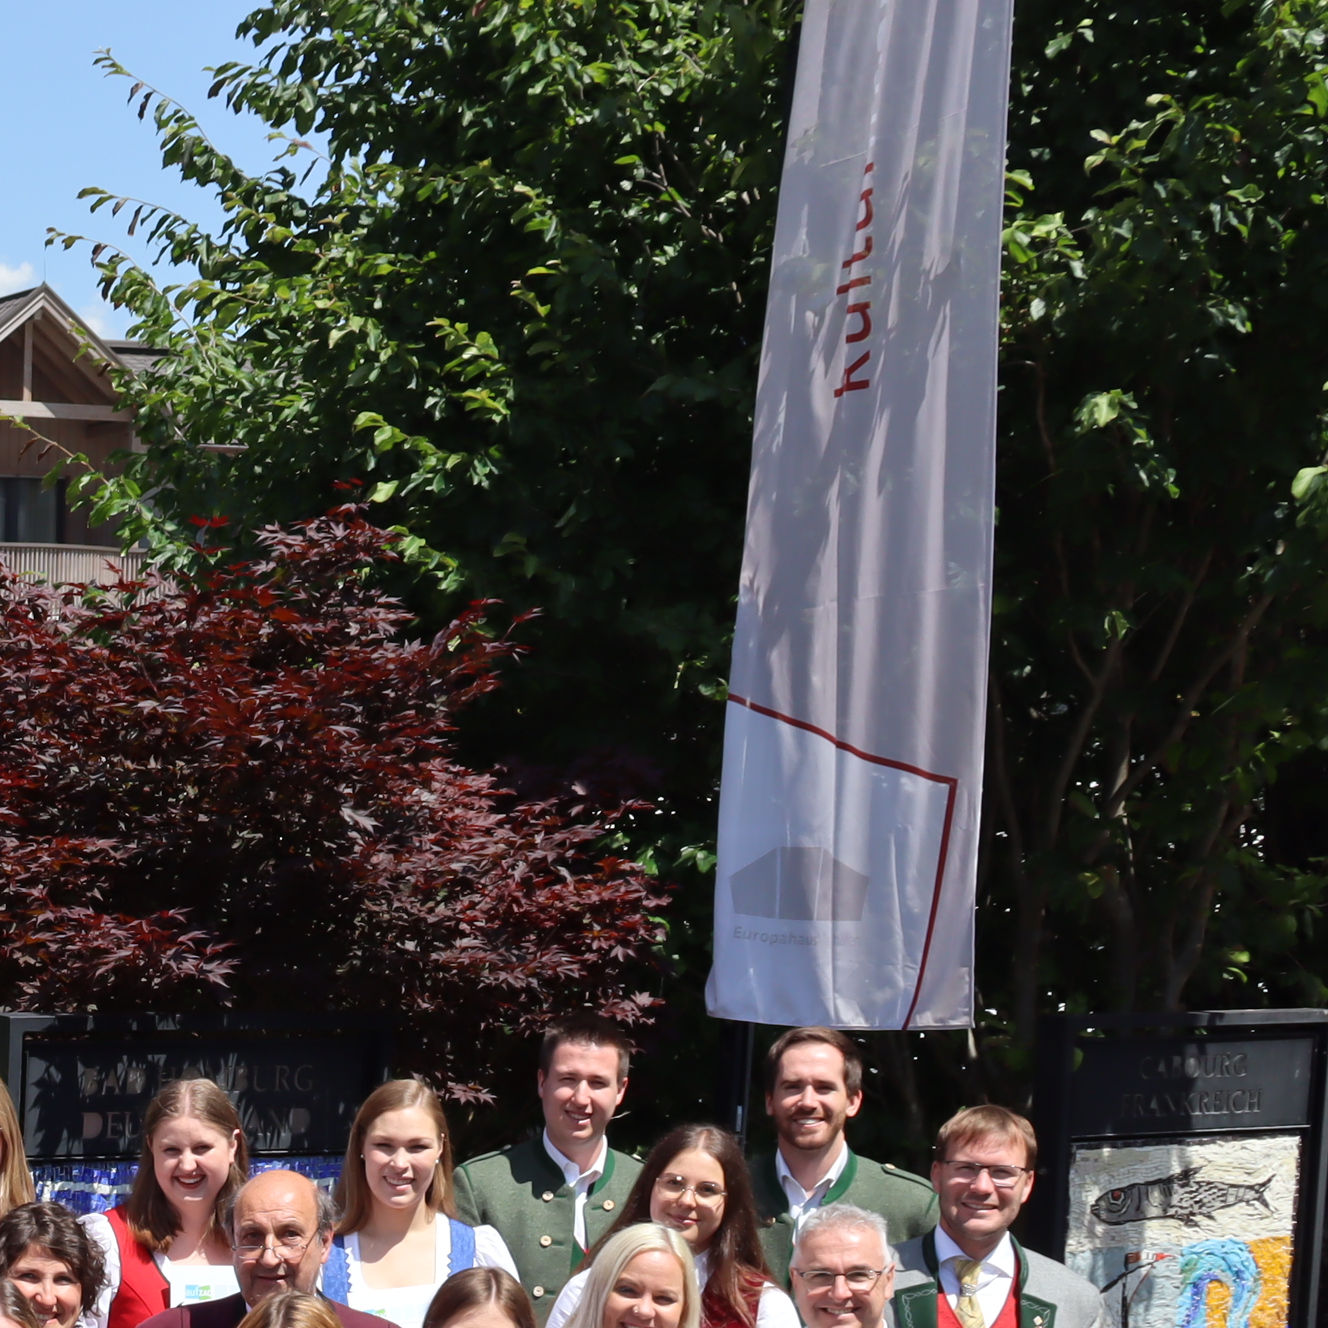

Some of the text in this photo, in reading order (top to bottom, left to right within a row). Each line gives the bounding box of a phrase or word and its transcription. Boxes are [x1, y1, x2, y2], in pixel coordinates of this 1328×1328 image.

[833, 162, 874, 399] kultu
[1140, 1052, 1248, 1080] CABOURG
[1120, 1089, 1262, 1117] FRANKREICH
[81, 1106, 311, 1139] DEUAND
